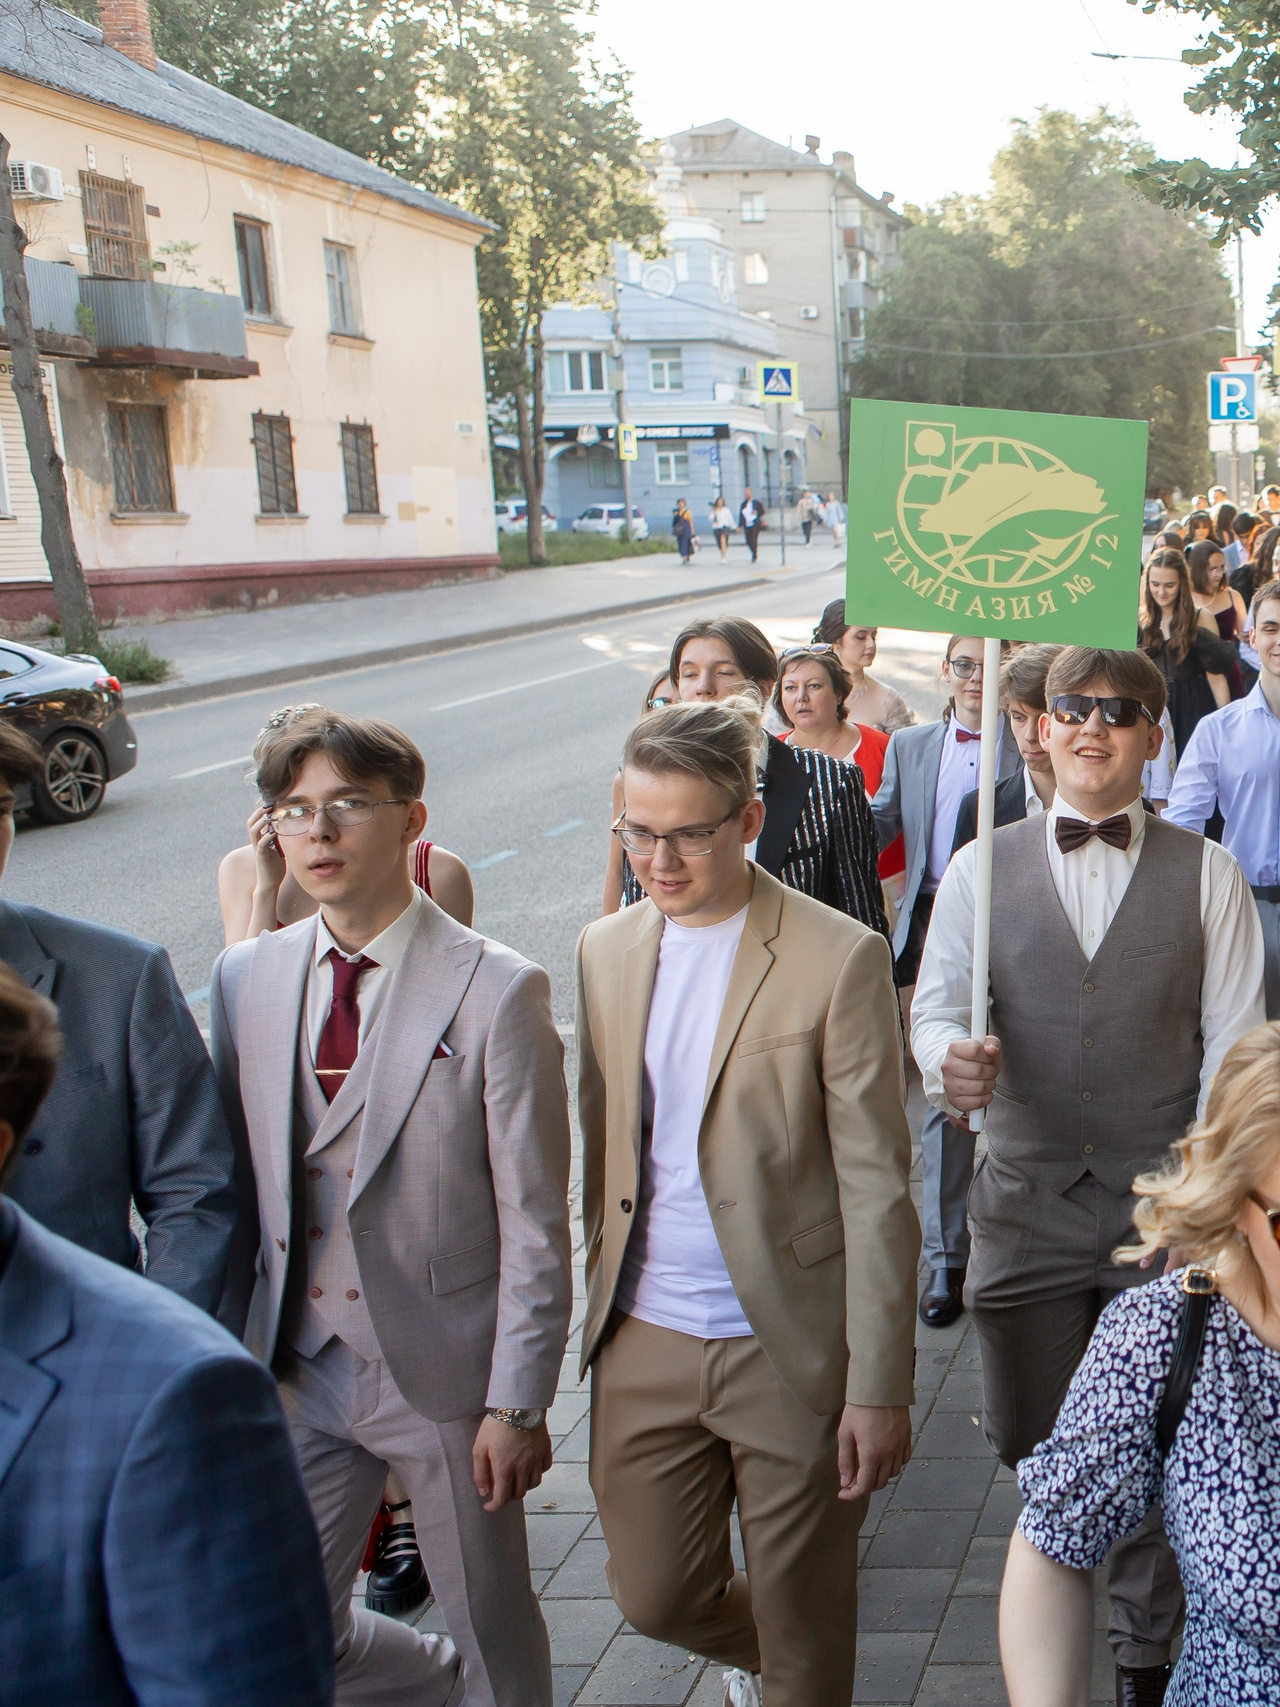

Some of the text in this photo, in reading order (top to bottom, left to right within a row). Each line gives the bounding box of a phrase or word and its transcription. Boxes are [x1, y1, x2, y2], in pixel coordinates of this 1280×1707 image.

[1220, 377, 1247, 416] P
[873, 527, 1119, 620] ГИМНАЗИЯ № 12
